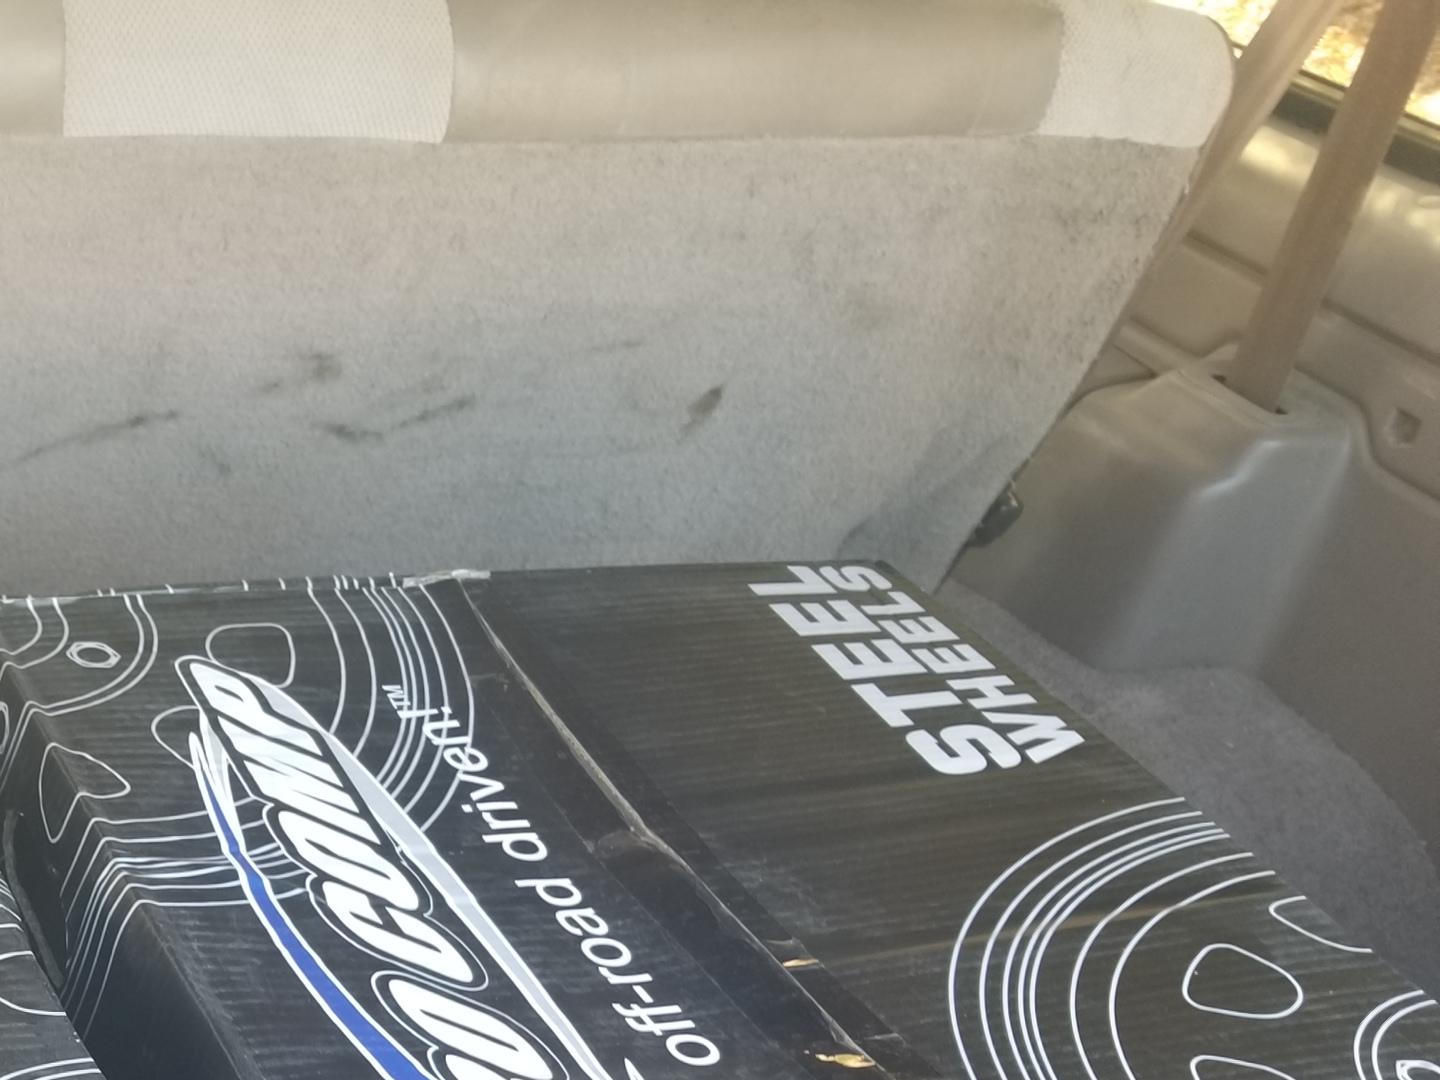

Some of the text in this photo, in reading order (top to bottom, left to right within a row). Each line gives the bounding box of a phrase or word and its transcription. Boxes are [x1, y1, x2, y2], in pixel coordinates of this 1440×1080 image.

[748, 565, 1022, 775] STEEL
[819, 565, 1086, 764] WHEELS
[188, 662, 473, 984] COMP
[514, 877, 721, 1067] off-road
